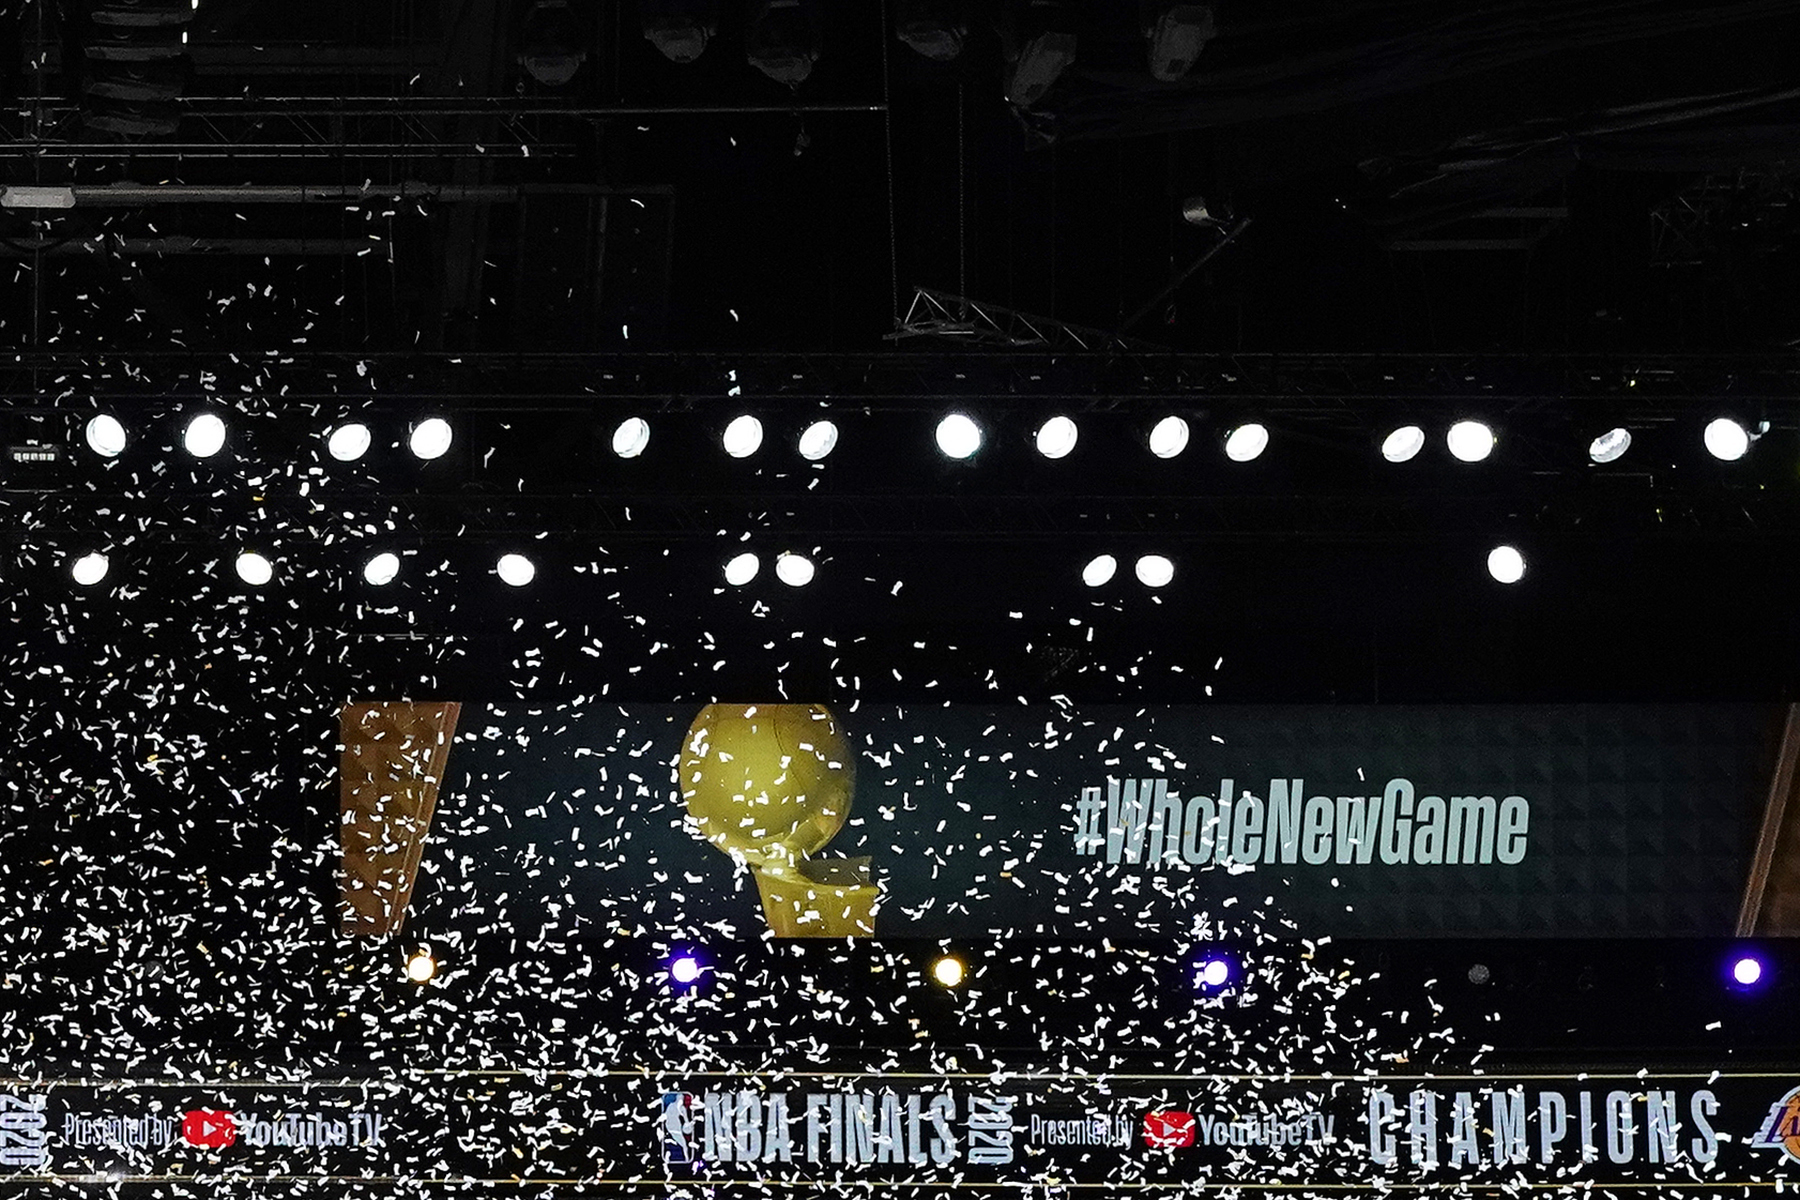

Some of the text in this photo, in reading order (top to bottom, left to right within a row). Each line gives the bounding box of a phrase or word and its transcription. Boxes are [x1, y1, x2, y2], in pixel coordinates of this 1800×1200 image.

[1073, 778, 1530, 865] #WholeNewGame
[704, 1092, 1014, 1165] NBA FINALS 2020
[1030, 1113, 1111, 1146] Presented
[1368, 1088, 1719, 1165] CHAMPIONS
